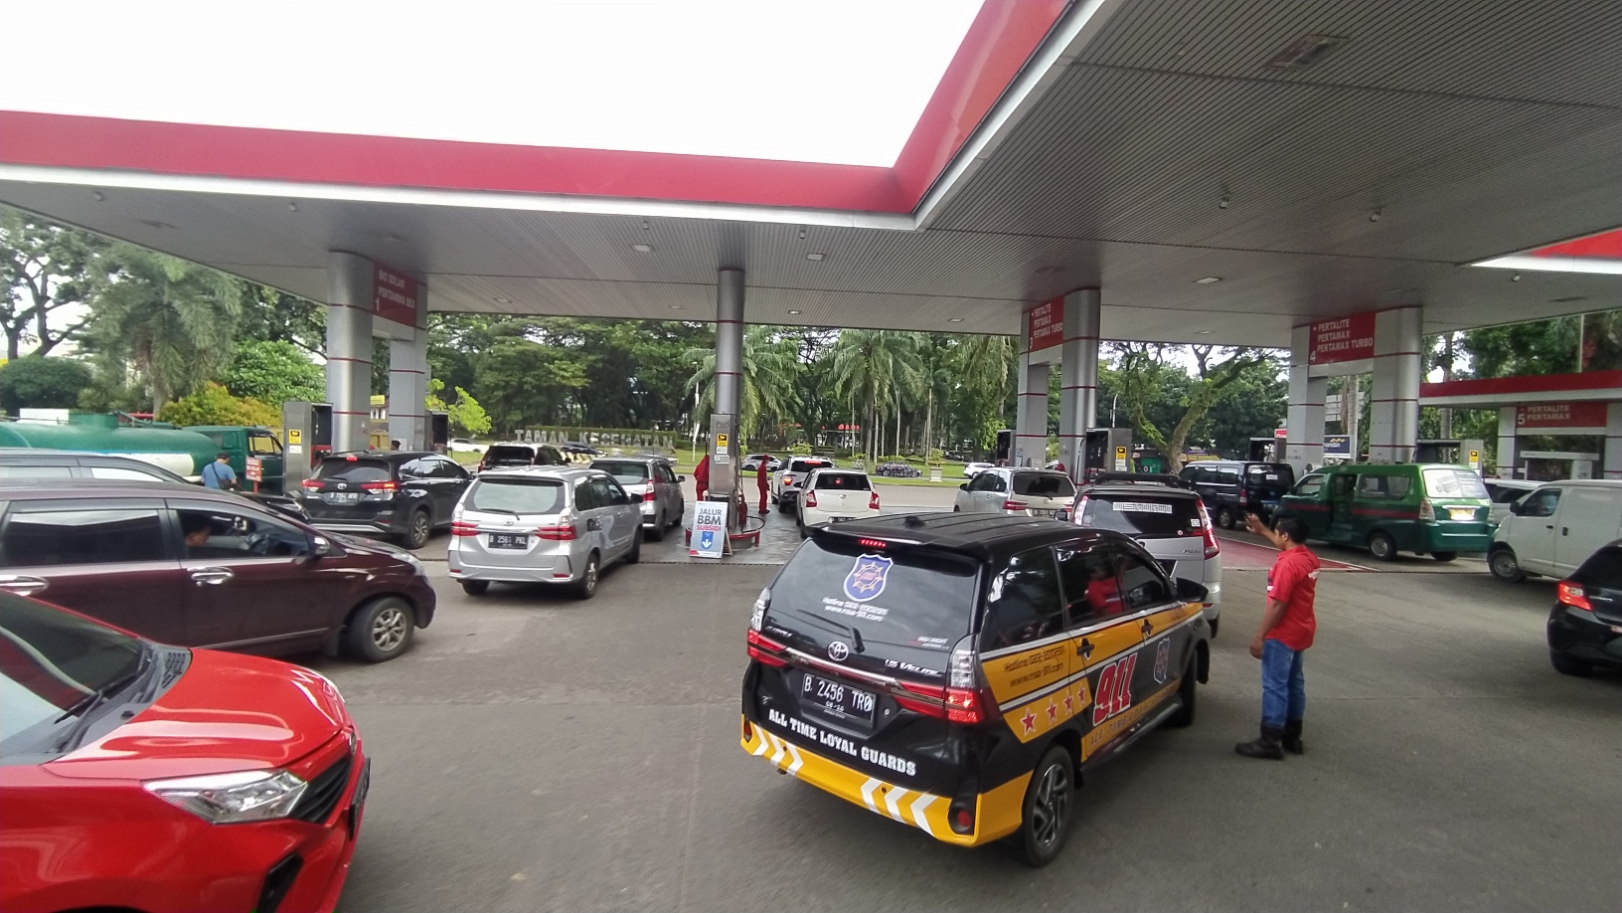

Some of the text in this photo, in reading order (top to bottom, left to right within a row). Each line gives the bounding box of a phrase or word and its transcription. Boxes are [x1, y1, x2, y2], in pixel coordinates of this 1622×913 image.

[389, 274, 405, 289] SOLAR
[375, 297, 380, 312] 1
[1318, 319, 1350, 332] PERTALITE
[1318, 330, 1350, 343] PERTAMAX
[1317, 337, 1374, 353] PERTAMAX TURBO
[1310, 350, 1316, 362] 4
[1527, 404, 1570, 412] PERTALITE
[1517, 413, 1526, 425] 5
[514, 429, 675, 449] TAMAN KESEHATAN
[699, 508, 723, 516] JALUR
[697, 515, 722, 525] BBM
[489, 535, 495, 543] B
[804, 675, 812, 692] B
[817, 680, 845, 703] 2456
[1093, 652, 1137, 727] 911
[769, 708, 917, 777] ALL TIME LOYAL GUARDS
